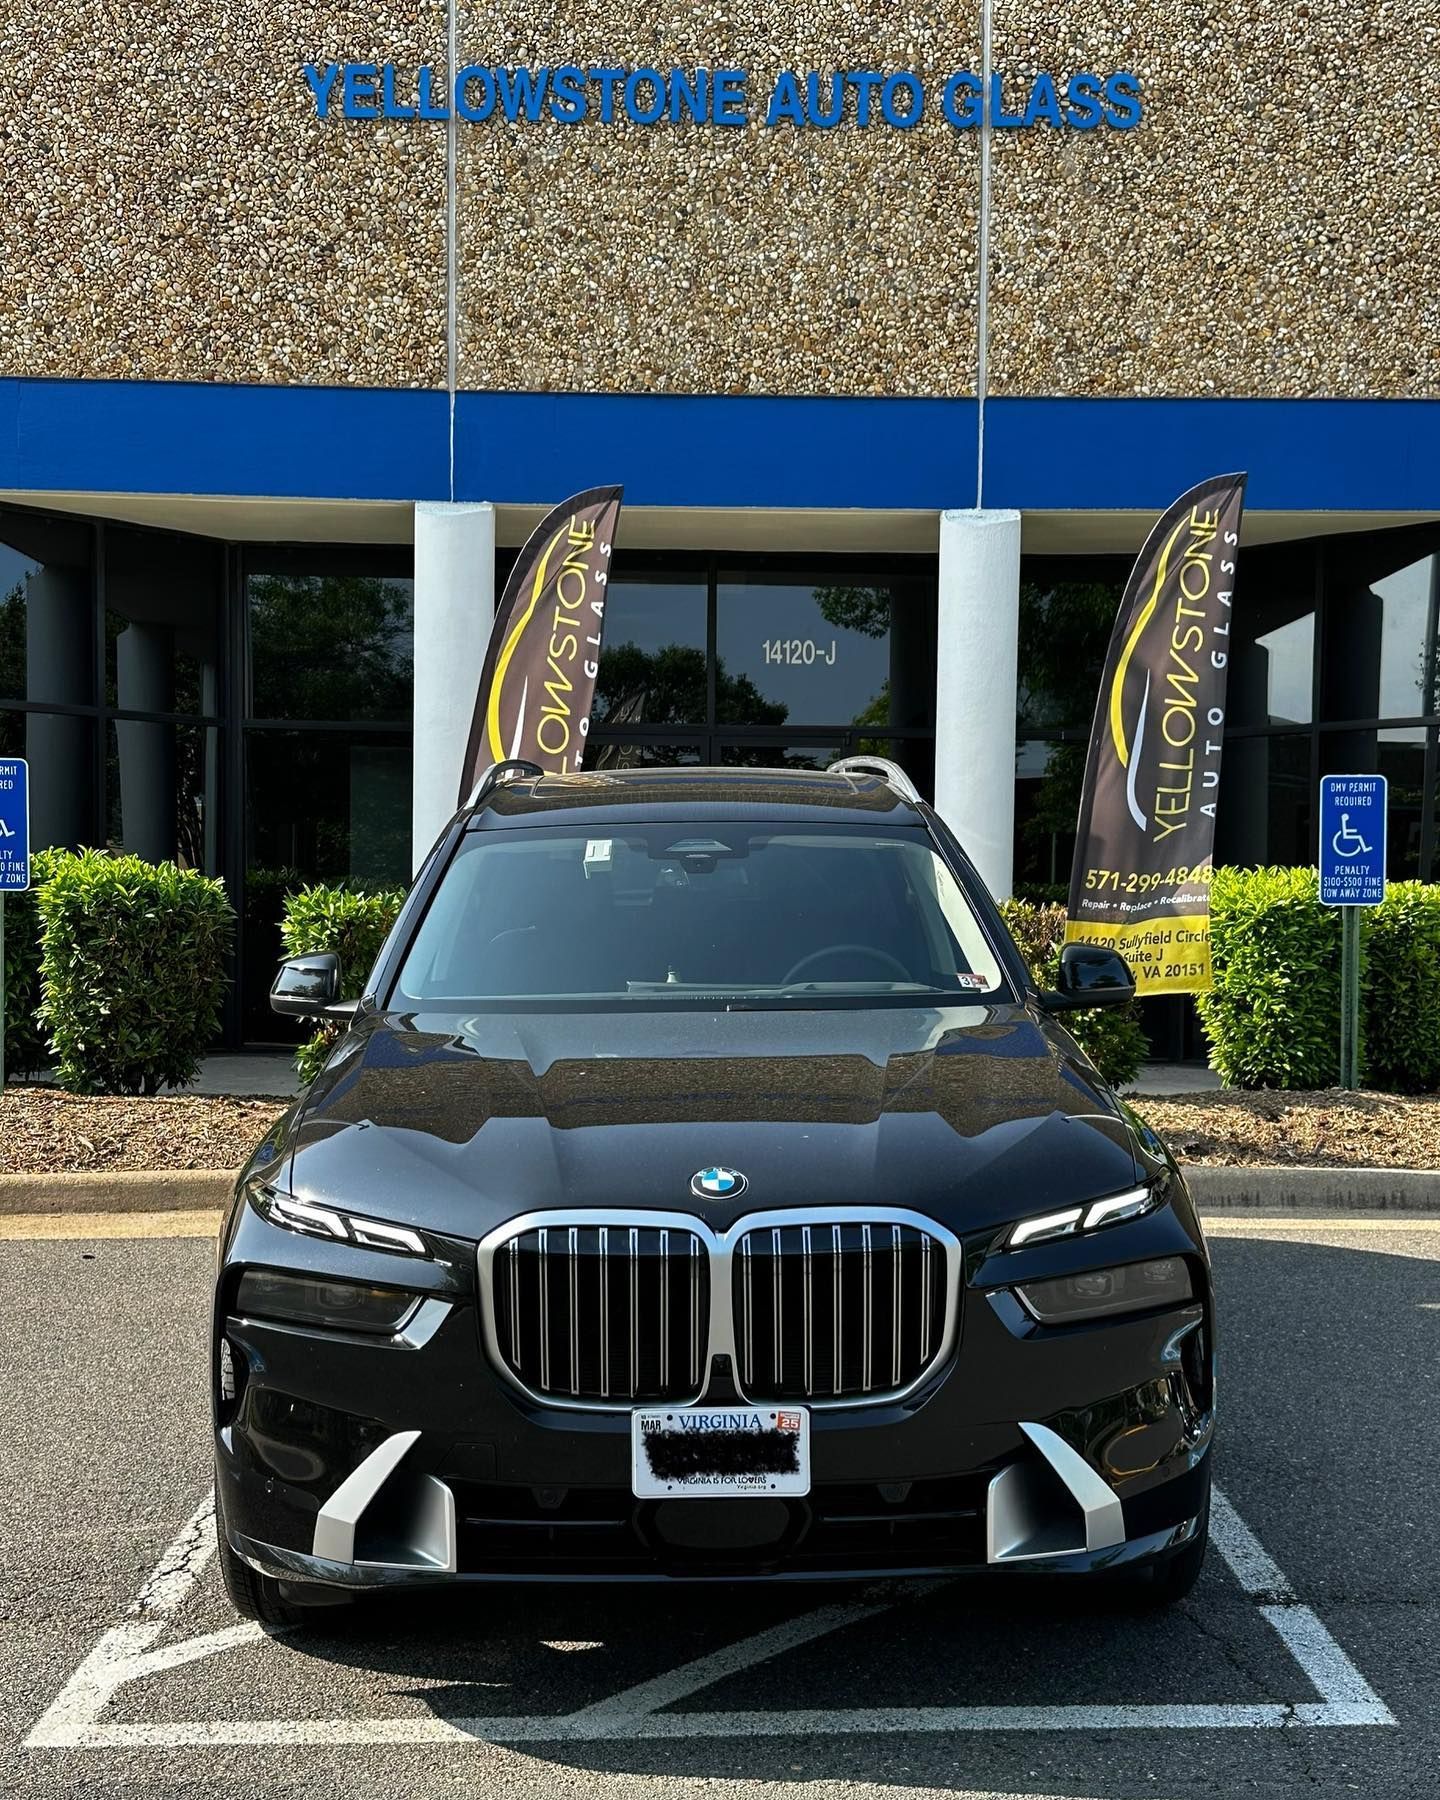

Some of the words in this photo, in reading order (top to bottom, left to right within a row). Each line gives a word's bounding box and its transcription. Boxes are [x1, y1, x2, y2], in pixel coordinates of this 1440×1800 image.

[304, 63, 748, 126] YELLOWSTONE
[765, 71, 925, 128] AUTO
[943, 72, 1144, 130] GLASS
[1211, 531, 1238, 669] GLASS
[583, 541, 612, 679] GLASS
[762, 639, 836, 665] 14120-J
[1153, 505, 1220, 843] YELLOWSTONE
[1200, 707, 1224, 818] AUTO
[1330, 782, 1347, 792] DMV
[1349, 782, 1377, 792] PERMIT
[1334, 796, 1372, 806] REQUIRED
[8, 862, 25, 872] FINE
[1334, 865, 1370, 875] PENALTY
[6, 874, 26, 883] ZONE
[1085, 865, 1213, 892] 571-299-4848
[1323, 876, 1363, 887] $100-$500
[1364, 877, 1382, 887] FINE
[1323, 888, 1338, 898] TOW
[1340, 888, 1361, 898] AWAY
[1362, 888, 1382, 898] ZONE
[1081, 898, 1110, 910] Repair
[1119, 901, 1152, 913] Replace
[1118, 929, 1172, 950] Sullyfield
[1175, 928, 1212, 943] Circle
[1156, 948, 1164, 962] J
[1142, 965, 1161, 979] VA
[1165, 962, 1205, 977] 20151
[641, 1420, 661, 1431] MAR
[678, 1413, 763, 1430] VIRGINIA
[781, 1418, 799, 1429] 25
